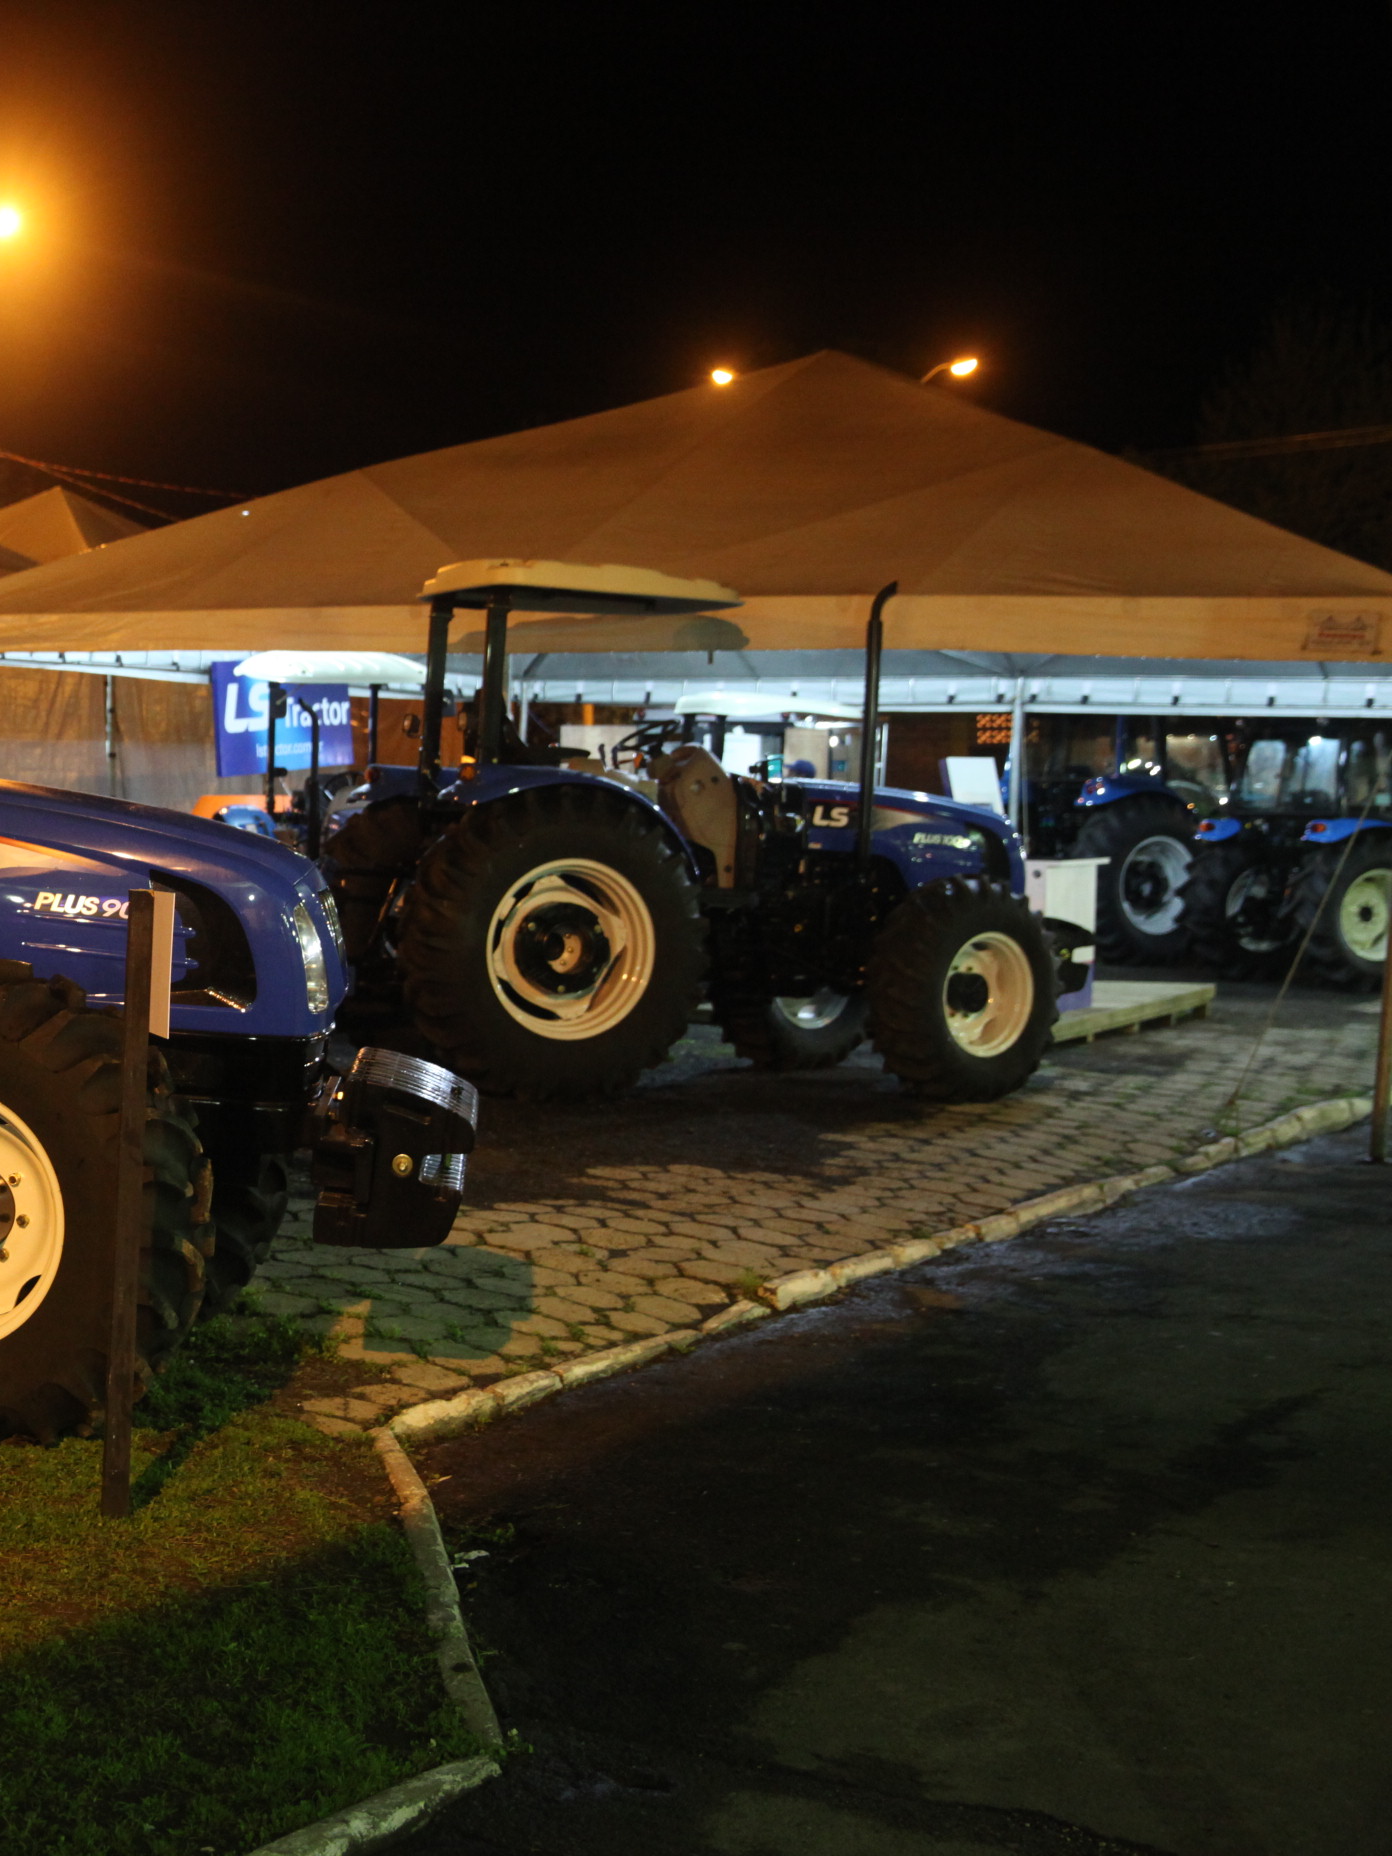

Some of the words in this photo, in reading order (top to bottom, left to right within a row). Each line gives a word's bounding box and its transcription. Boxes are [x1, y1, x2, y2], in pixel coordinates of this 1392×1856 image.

[224, 682, 270, 734] LS
[812, 805, 849, 827] LS
[33, 891, 100, 916] PLUS
